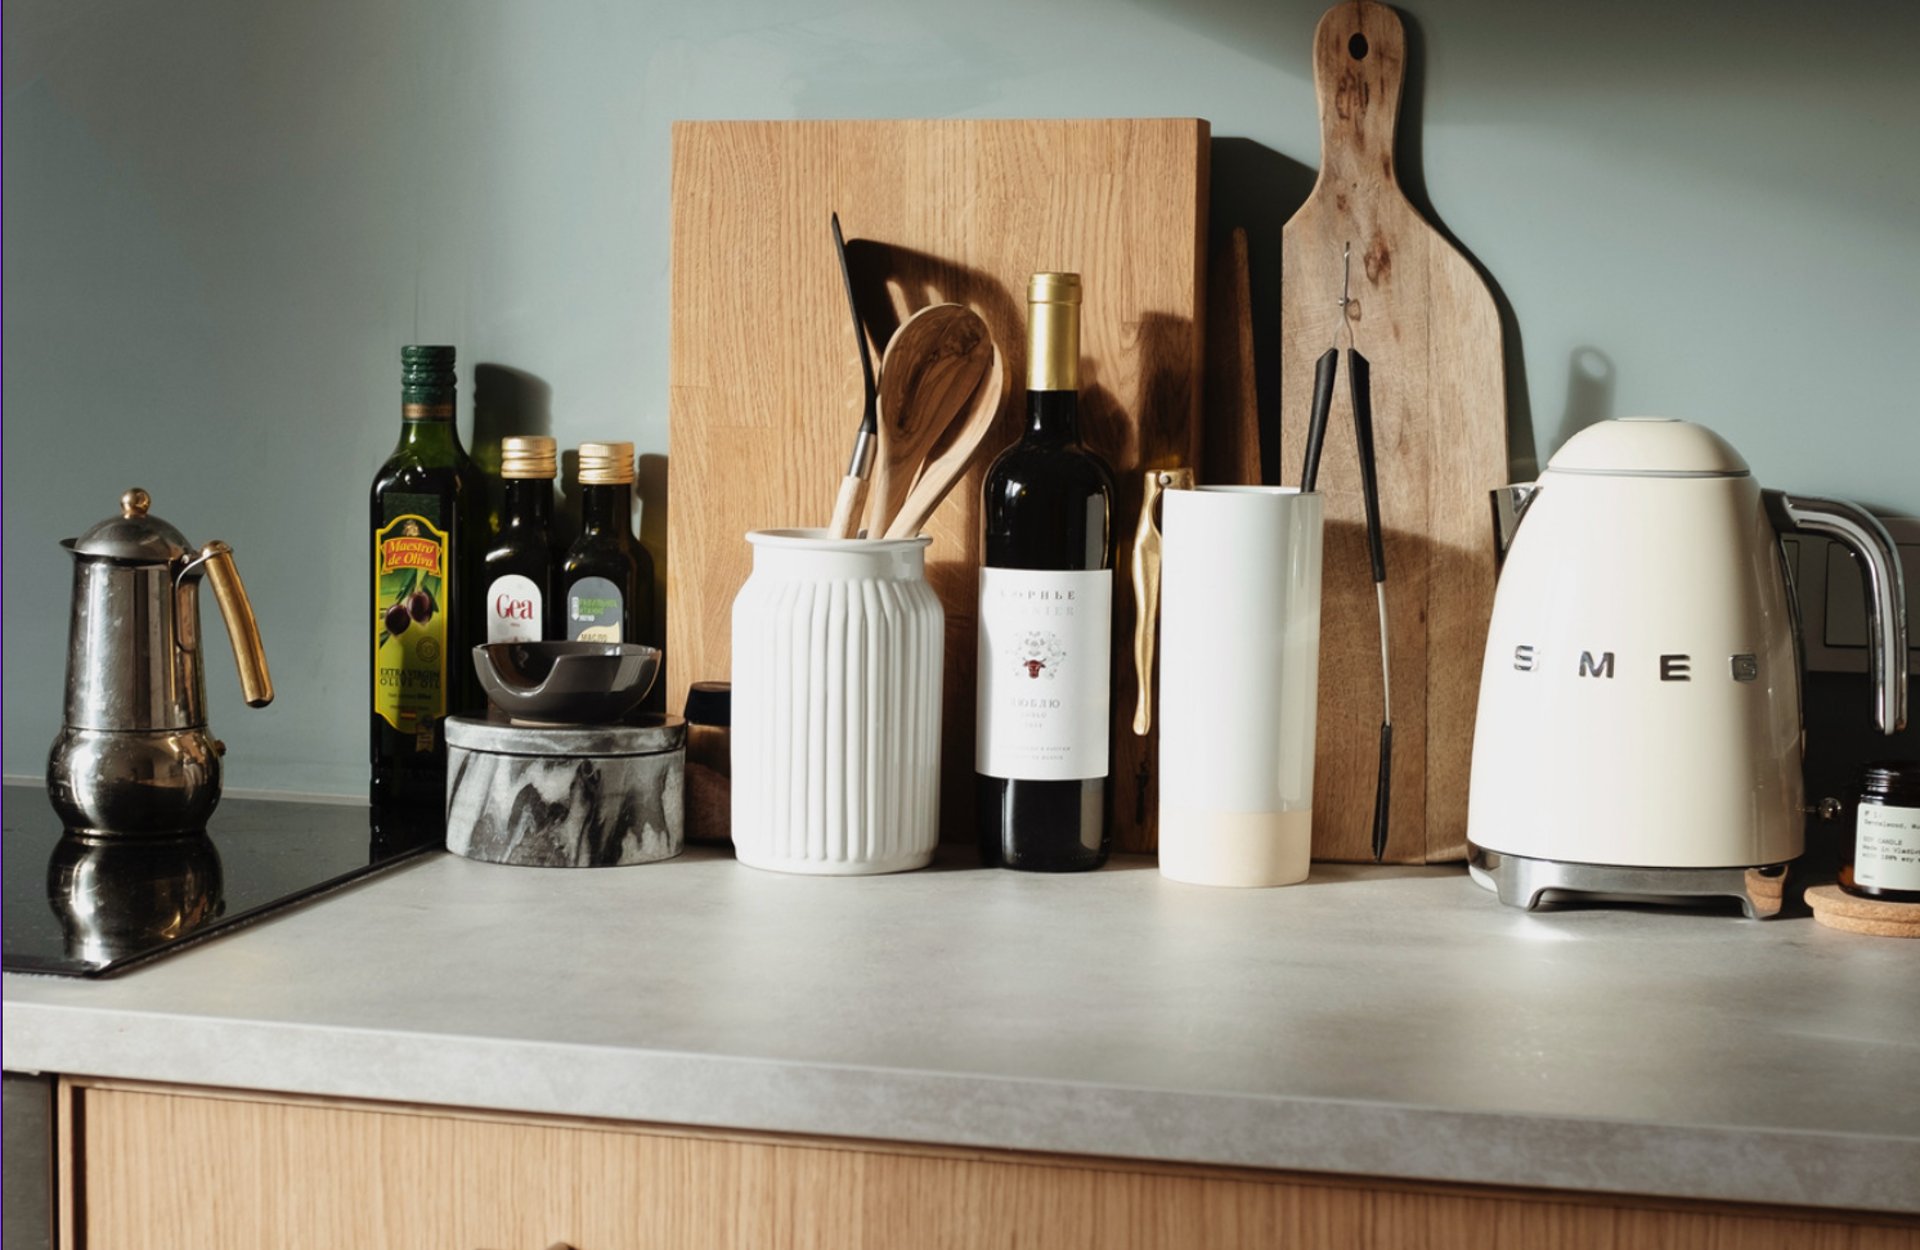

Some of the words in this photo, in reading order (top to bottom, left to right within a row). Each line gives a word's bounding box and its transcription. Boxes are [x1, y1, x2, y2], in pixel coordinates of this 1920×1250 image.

[389, 540, 435, 553] Maestro
[387, 554, 401, 566] de
[403, 551, 433, 567] Oliva
[496, 593, 533, 620] Gea
[1513, 644, 1757, 683] SMEG
[380, 668, 407, 677] EXTRA
[380, 678, 412, 687] OLIVE
[420, 680, 440, 689] OIL
